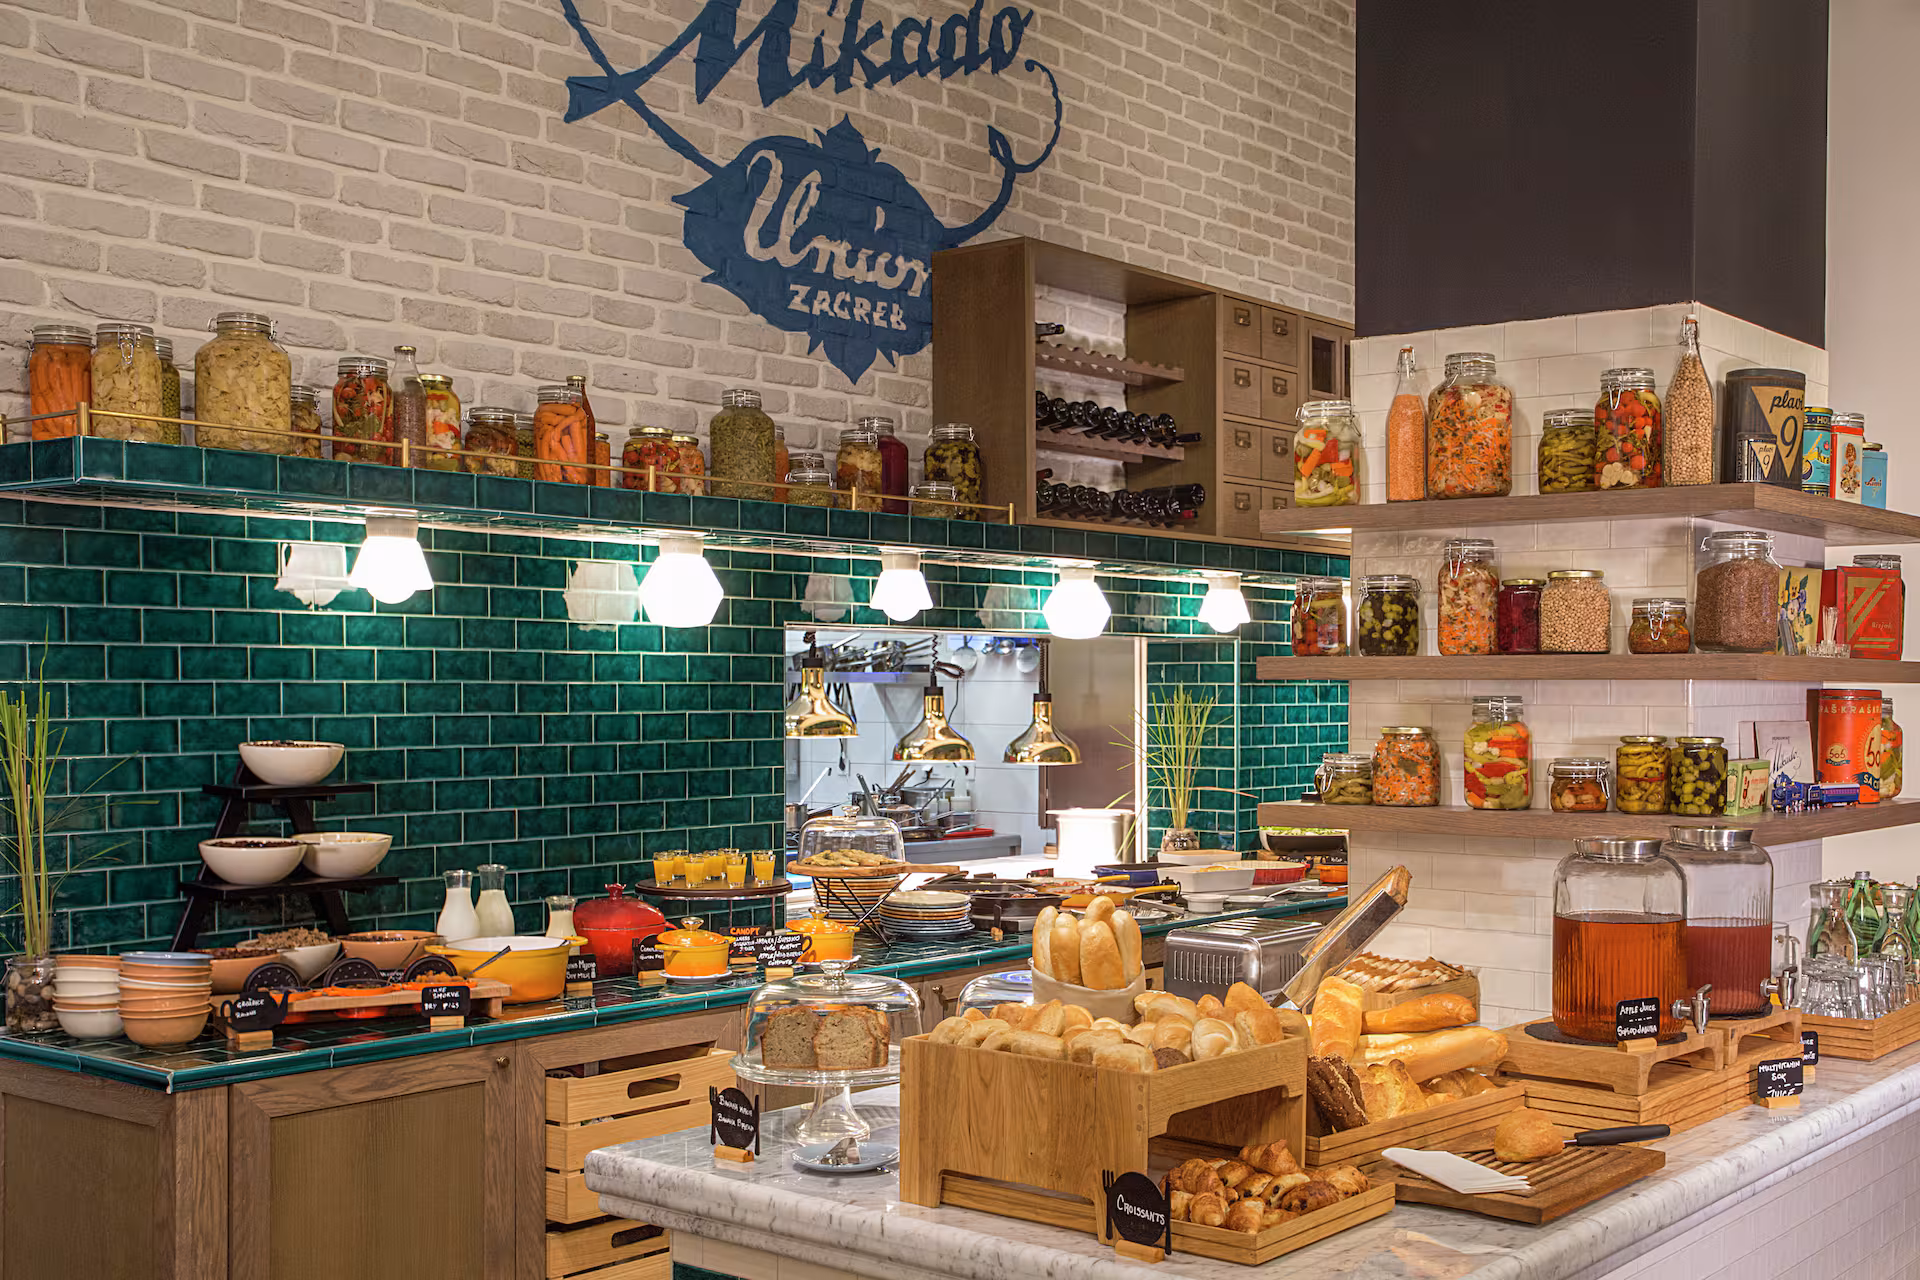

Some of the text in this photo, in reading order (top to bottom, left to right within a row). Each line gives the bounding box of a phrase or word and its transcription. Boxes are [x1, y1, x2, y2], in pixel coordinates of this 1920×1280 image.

[655, 0, 1034, 108] Mikado
[787, 283, 908, 331] ZAGREB
[1779, 415, 1798, 459] 9
[1762, 454, 1771, 470] 9
[1828, 748, 1846, 759] 505
[729, 927, 761, 936] CANOPY
[1619, 1001, 1657, 1016] APPLE JUICE
[1116, 1193, 1166, 1226] CROISSANTS
